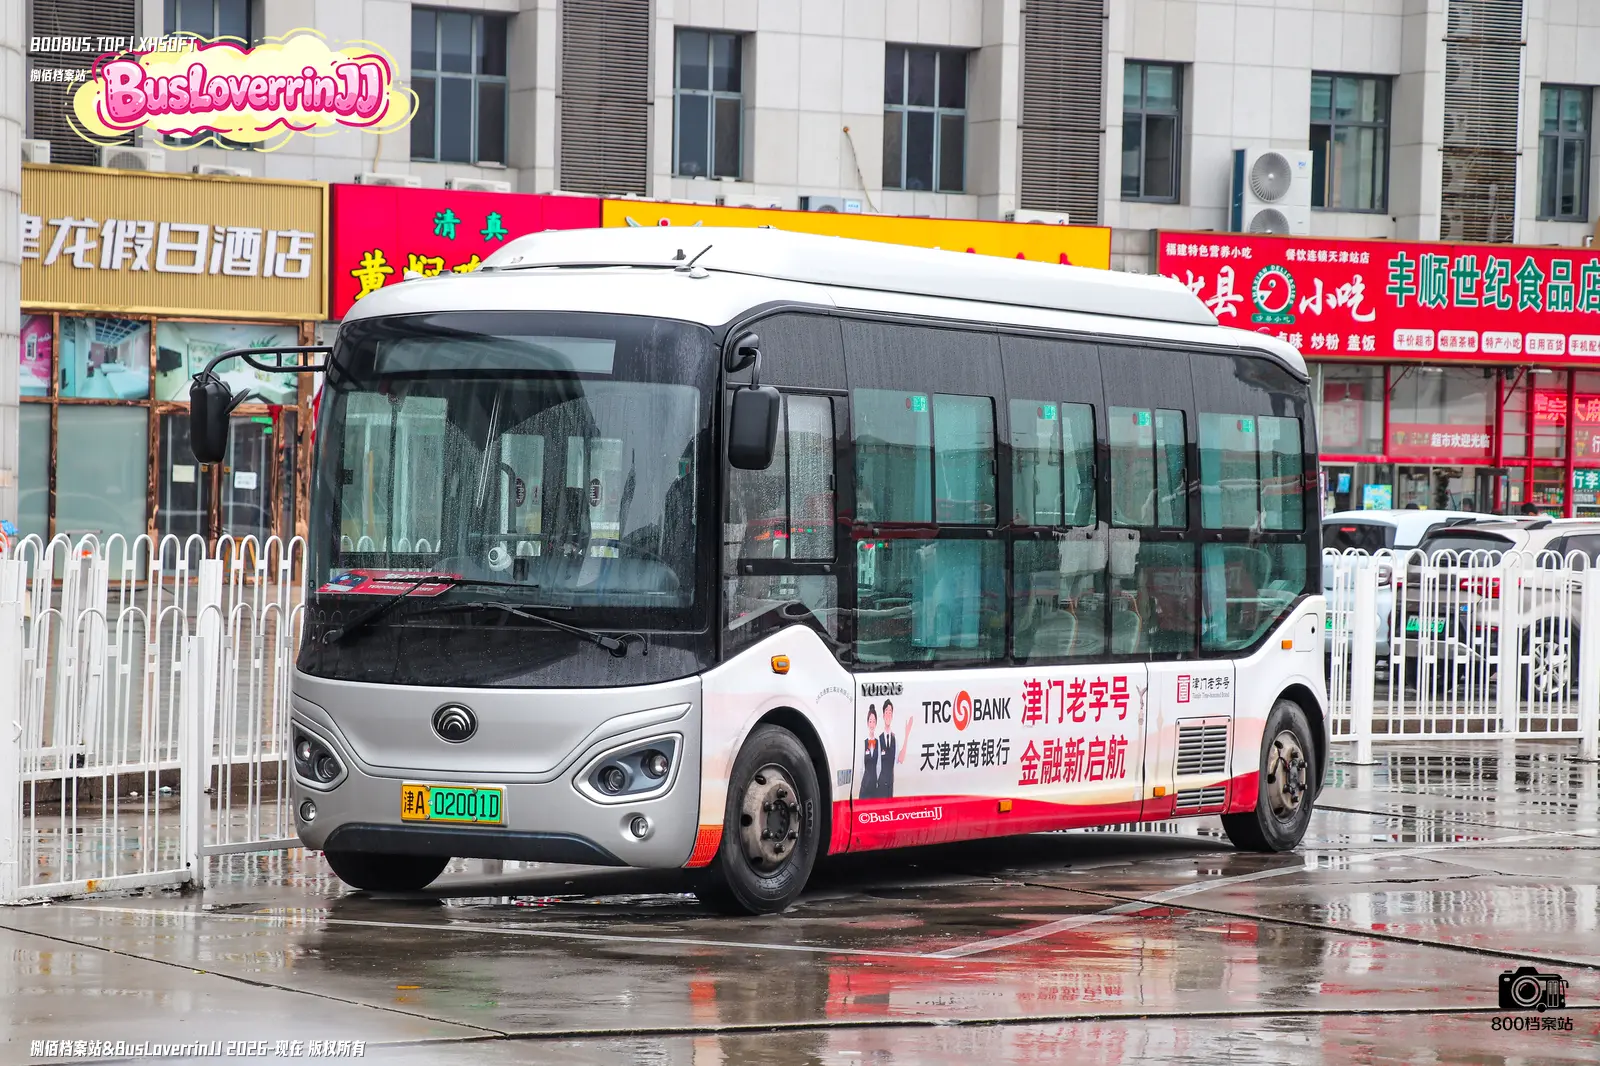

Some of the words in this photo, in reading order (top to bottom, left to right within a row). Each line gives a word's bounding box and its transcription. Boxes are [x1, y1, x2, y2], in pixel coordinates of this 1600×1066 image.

[434, 208, 508, 241] 清真
[1166, 242, 1253, 259] 福建特色营养小吃
[1286, 248, 1370, 264] 餐饮连锁天津站店
[1298, 274, 1376, 322] 小吃
[1311, 333, 1339, 350] 炒粉
[1347, 334, 1375, 352] 盖饭
[1397, 334, 1433, 347] 平价超市
[1440, 335, 1476, 348] 烟酒茶糖
[1485, 336, 1521, 350] 特产小吃
[1529, 338, 1564, 351] 日用百货
[1431, 432, 1490, 449] 超市欢迎光临
[861, 682, 903, 697] YUTONG
[1192, 676, 1230, 690] 津门老字号
[1021, 676, 1130, 726] 津门老字号
[922, 700, 952, 724] TRC
[973, 697, 1011, 721] BANK
[920, 738, 1010, 771] 天津农商银行
[1018, 734, 1128, 785] 金融新启航
